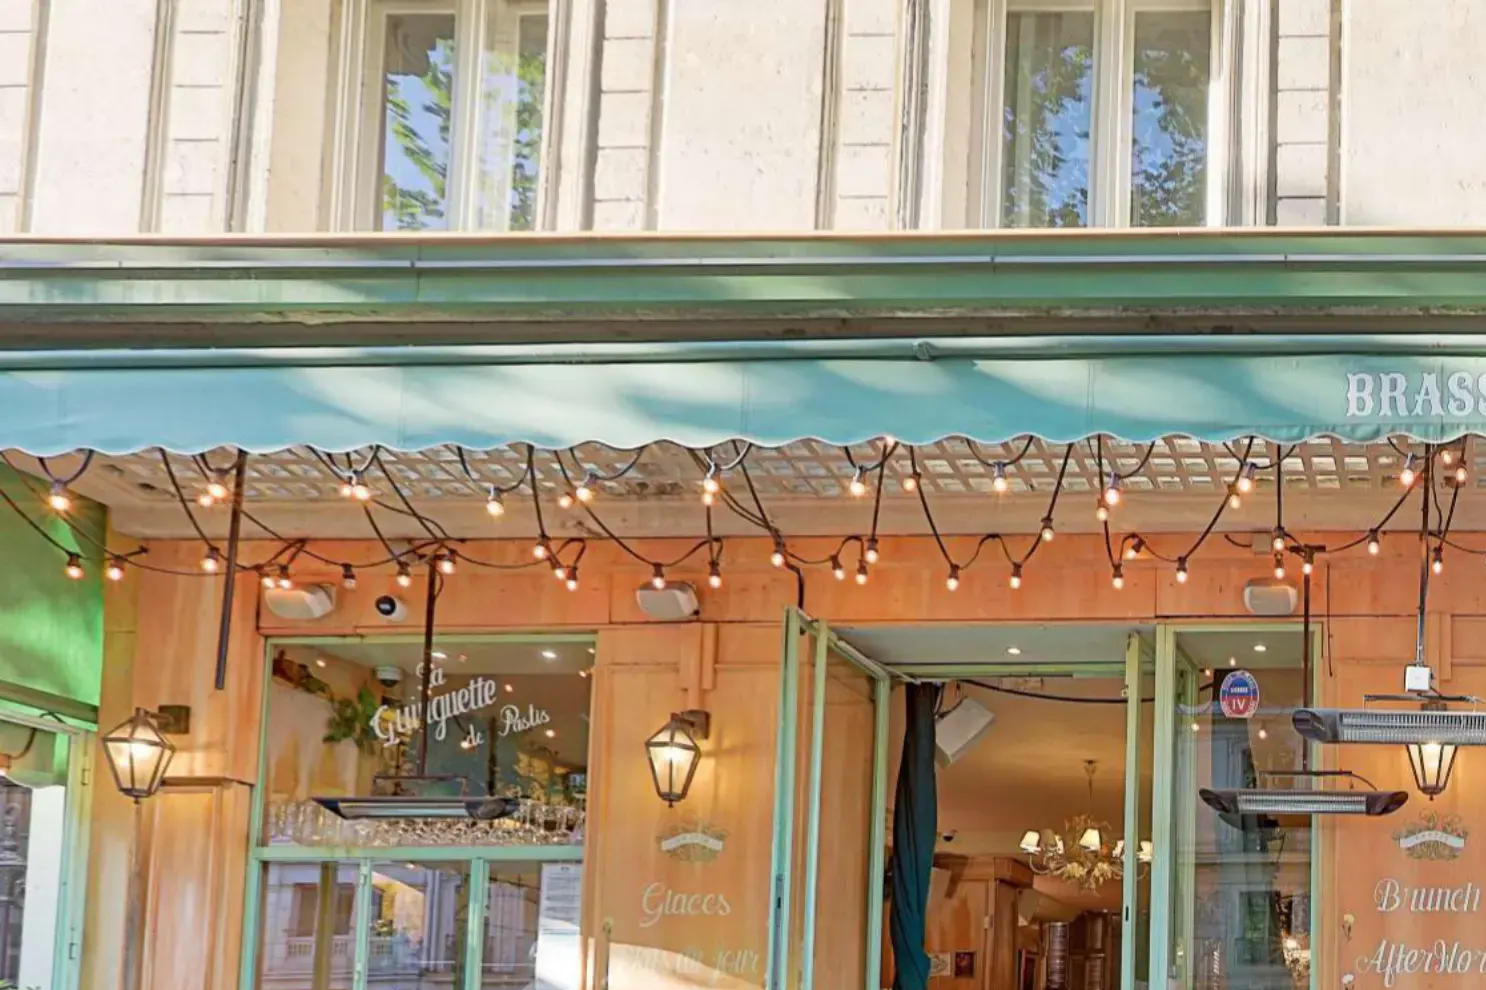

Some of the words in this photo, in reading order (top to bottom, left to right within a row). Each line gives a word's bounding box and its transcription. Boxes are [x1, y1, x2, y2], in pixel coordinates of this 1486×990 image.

[498, 704, 550, 736] Pastis
[1232, 698, 1246, 711] IV
[639, 881, 731, 928] Glaces
[1374, 877, 1481, 913] Brunch
